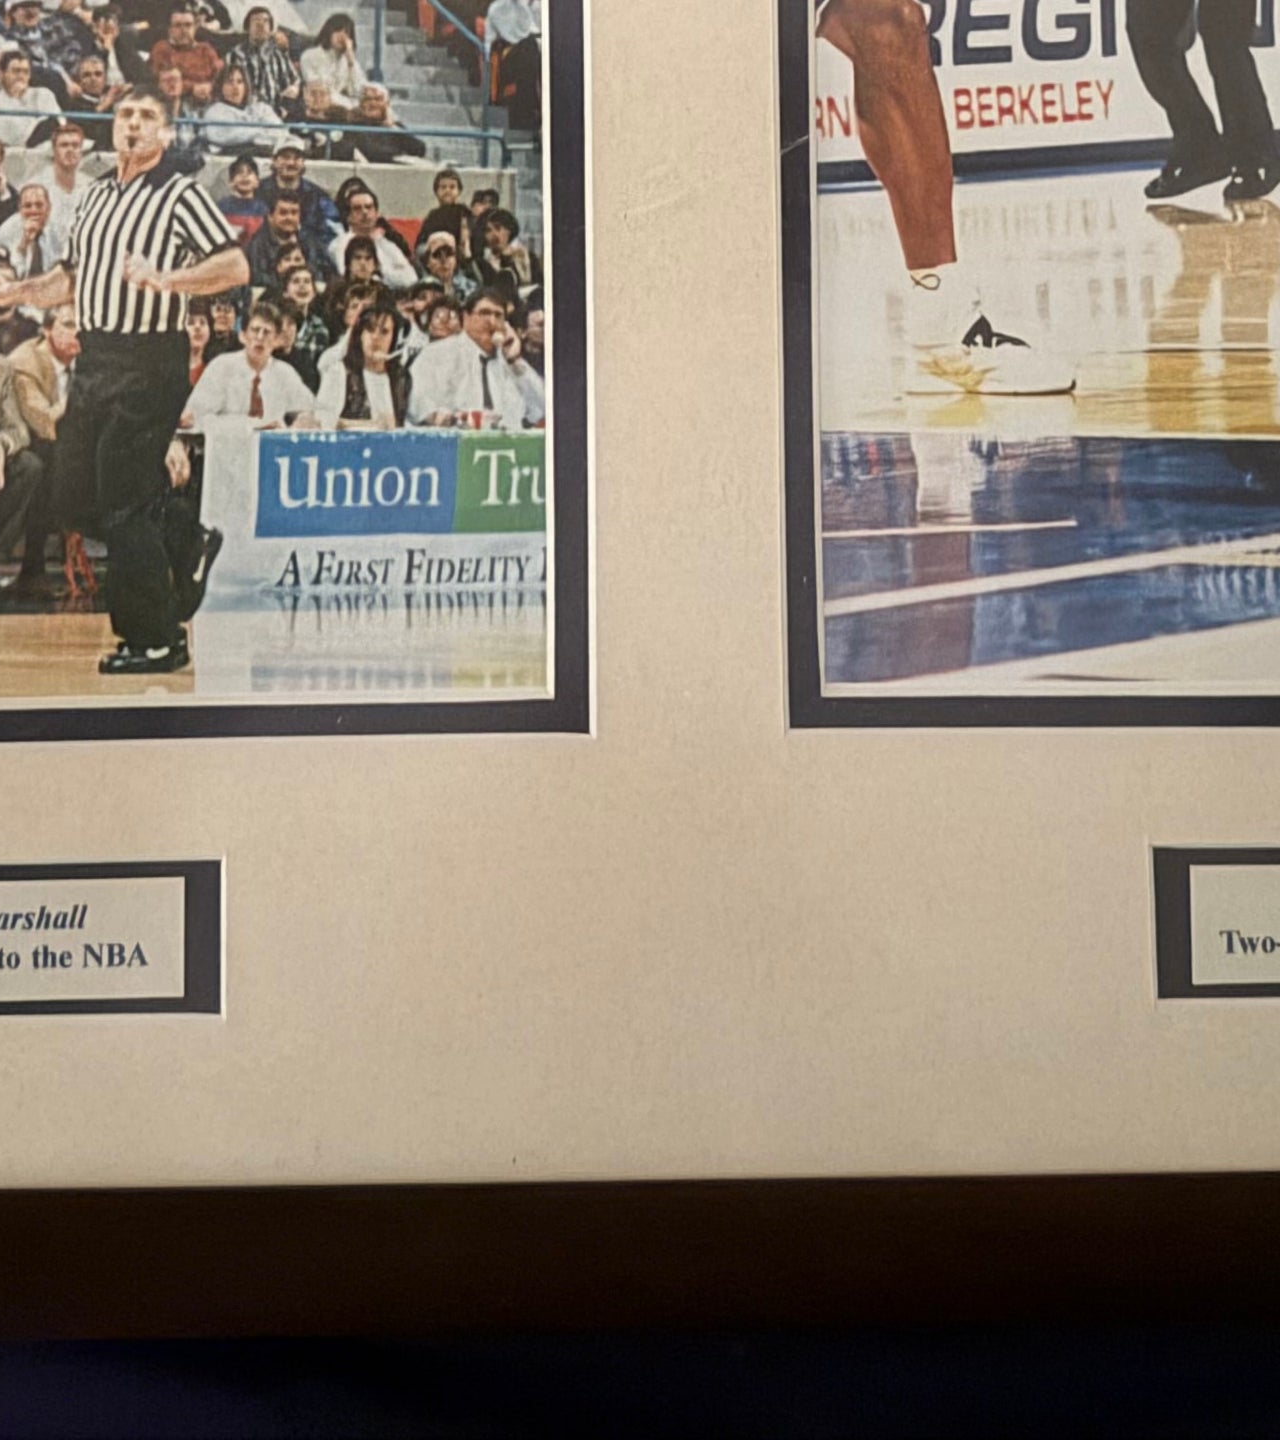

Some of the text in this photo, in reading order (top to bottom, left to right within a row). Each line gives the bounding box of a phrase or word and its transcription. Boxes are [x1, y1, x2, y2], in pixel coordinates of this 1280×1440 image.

[953, 79, 1115, 130] BERKELEY
[274, 448, 441, 508] Union
[275, 550, 302, 587] A
[308, 550, 396, 586] FIRST
[405, 548, 533, 586] FIDELITY
[31, 943, 73, 969] the
[82, 941, 149, 968] NBA
